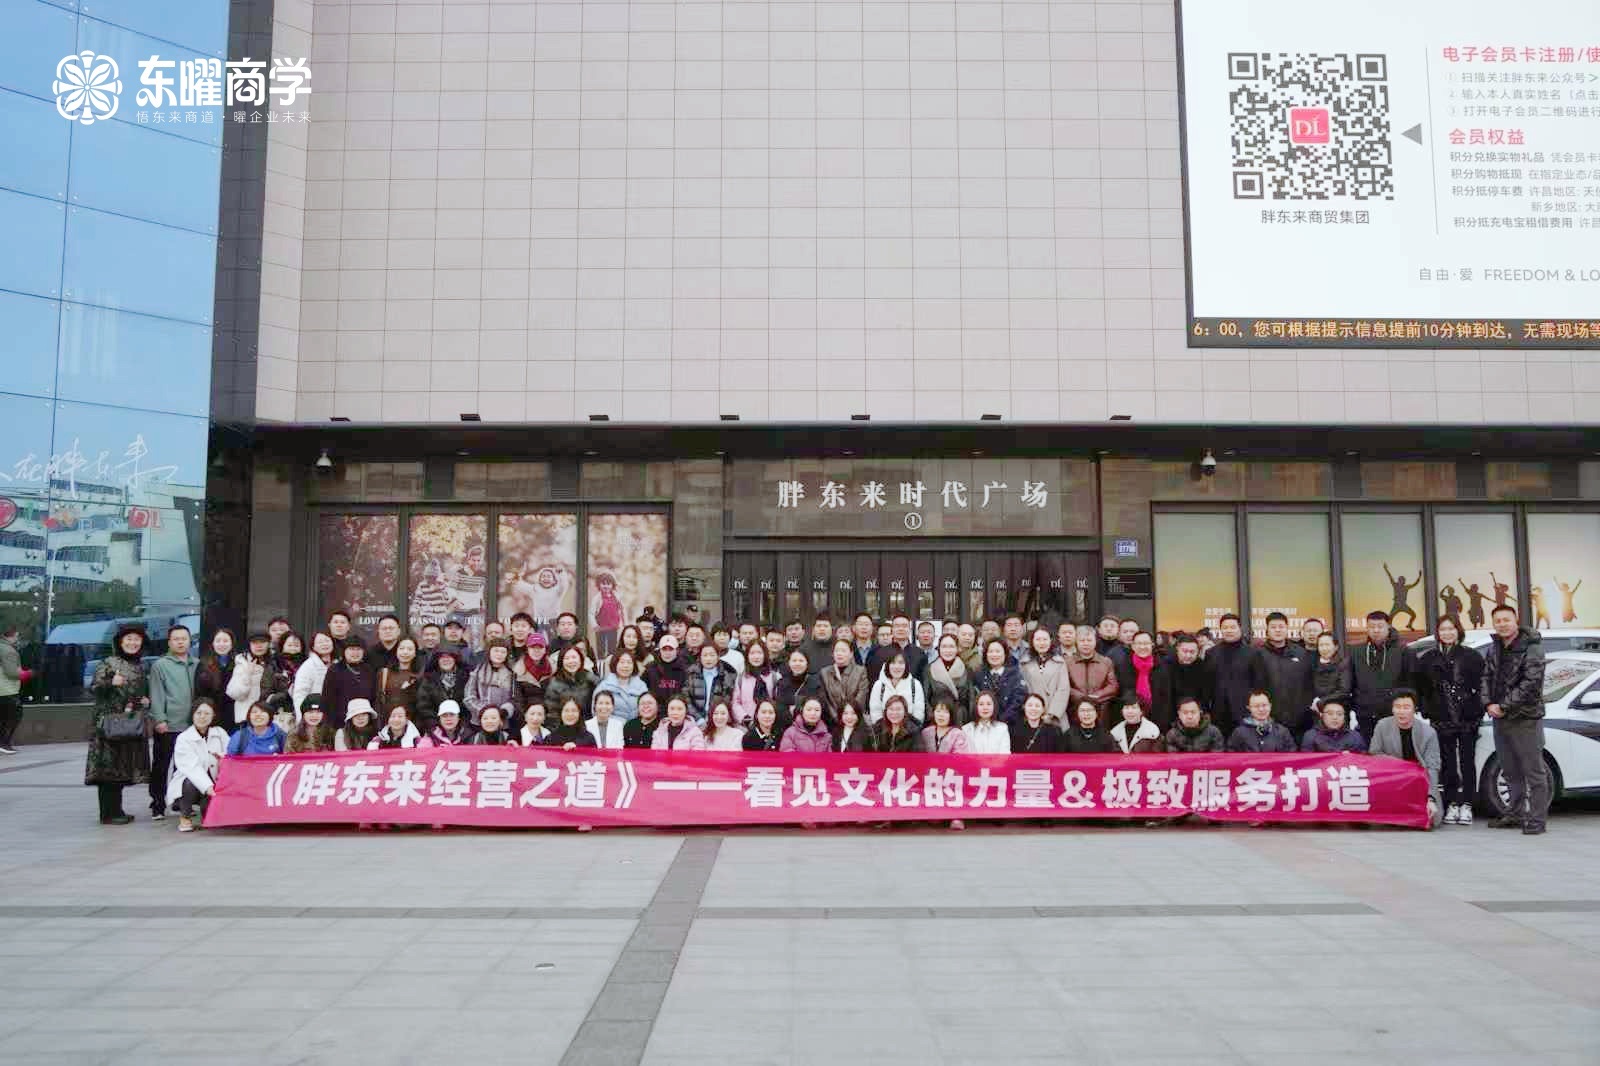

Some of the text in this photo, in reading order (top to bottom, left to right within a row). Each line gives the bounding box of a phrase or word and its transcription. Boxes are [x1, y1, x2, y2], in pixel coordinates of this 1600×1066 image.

[1449, 128, 1525, 146] 会员权益
[1450, 151, 1545, 163] 积分兑换实物礼品
[1451, 168, 1523, 180] 积分购物抵现
[1452, 185, 1523, 197] 积分抵停车费
[1260, 209, 1370, 225] 胖东来商贸集团
[1453, 216, 1574, 229] 积分抵充电宝租借费用
[1484, 269, 1559, 281] FREEDOM
[1565, 269, 1576, 281] &
[777, 480, 1049, 508] 胖东来时代广场
